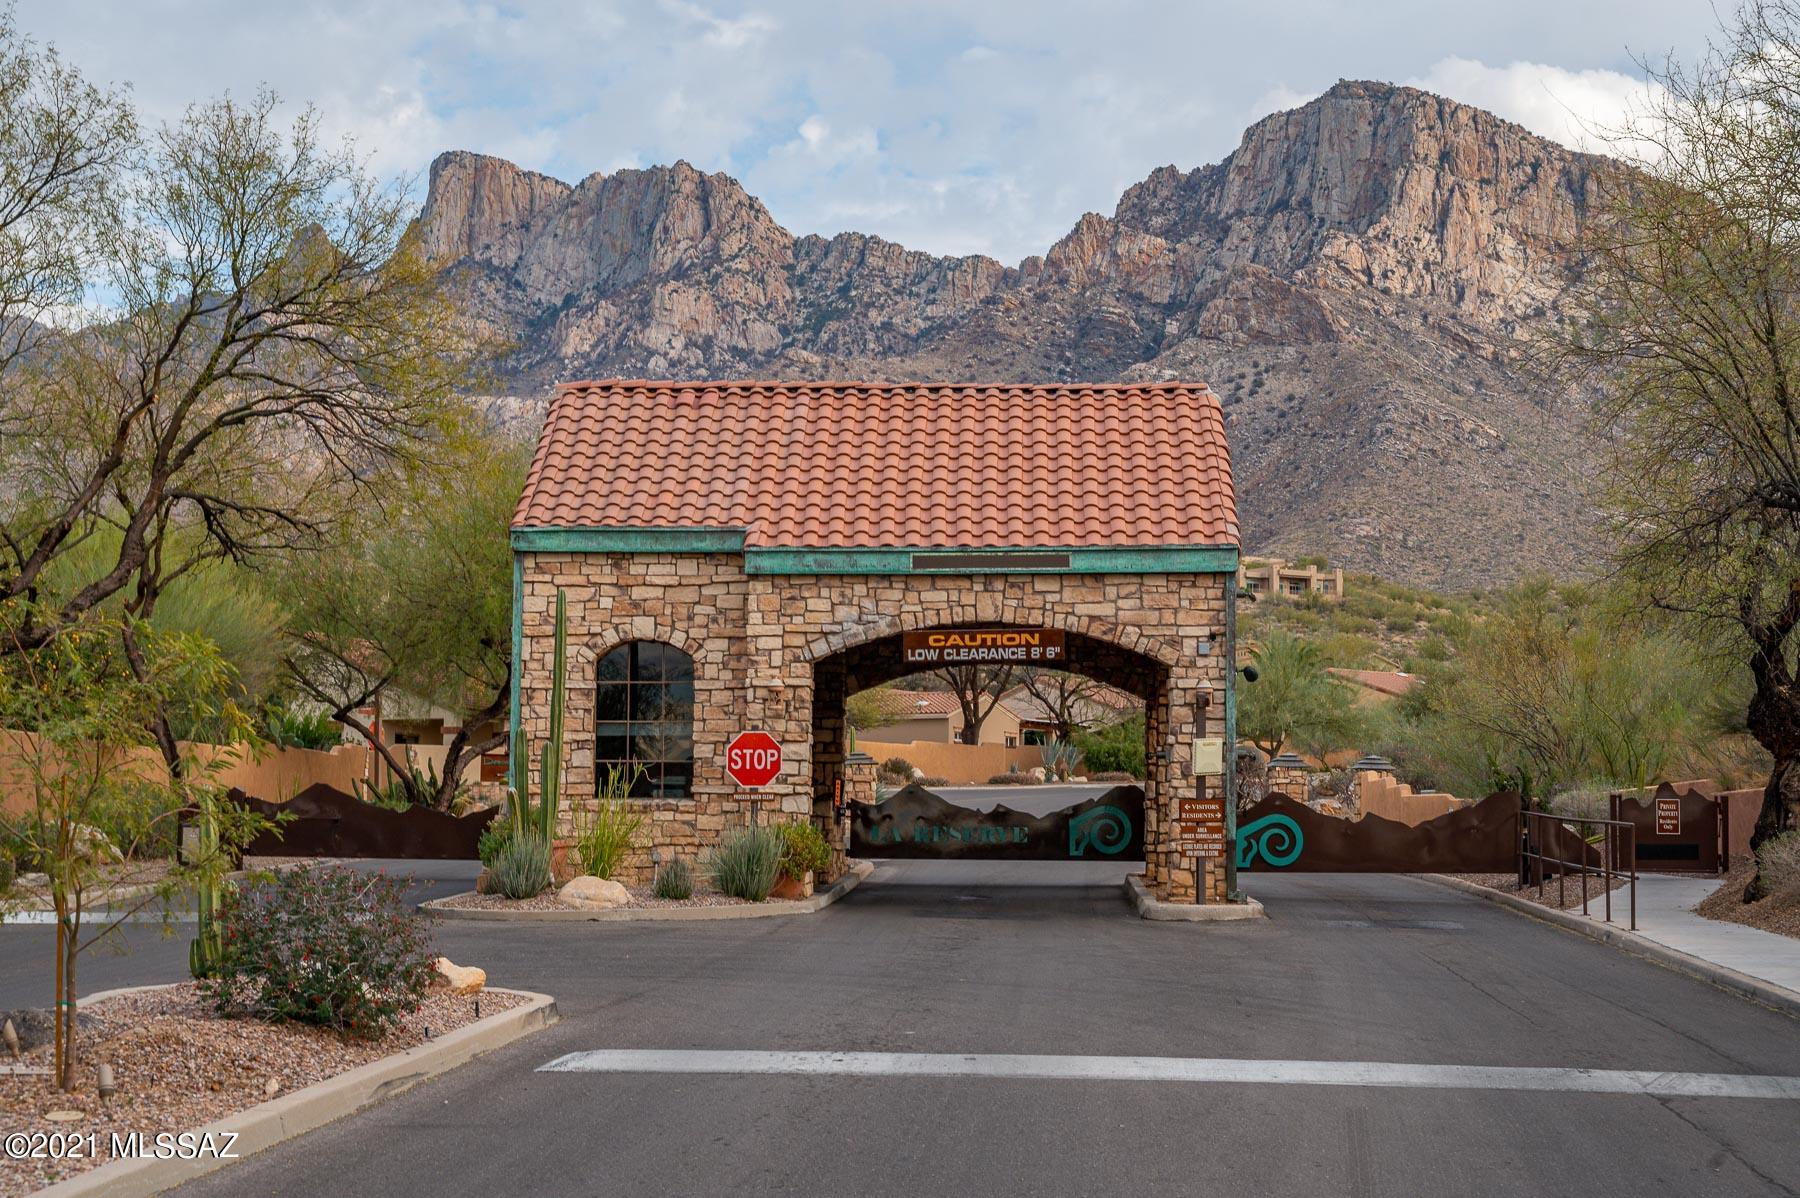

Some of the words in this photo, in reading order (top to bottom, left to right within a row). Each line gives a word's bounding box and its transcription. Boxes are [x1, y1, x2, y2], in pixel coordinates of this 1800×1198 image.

[928, 633, 1040, 647] CAUTION
[908, 648, 939, 661] LOW
[944, 647, 1027, 661] CLEARANCE
[1031, 647, 1043, 659] 8'
[1046, 646, 1061, 658] 6"
[730, 748, 779, 770] STOP
[913, 825, 1030, 844] RESERVE
